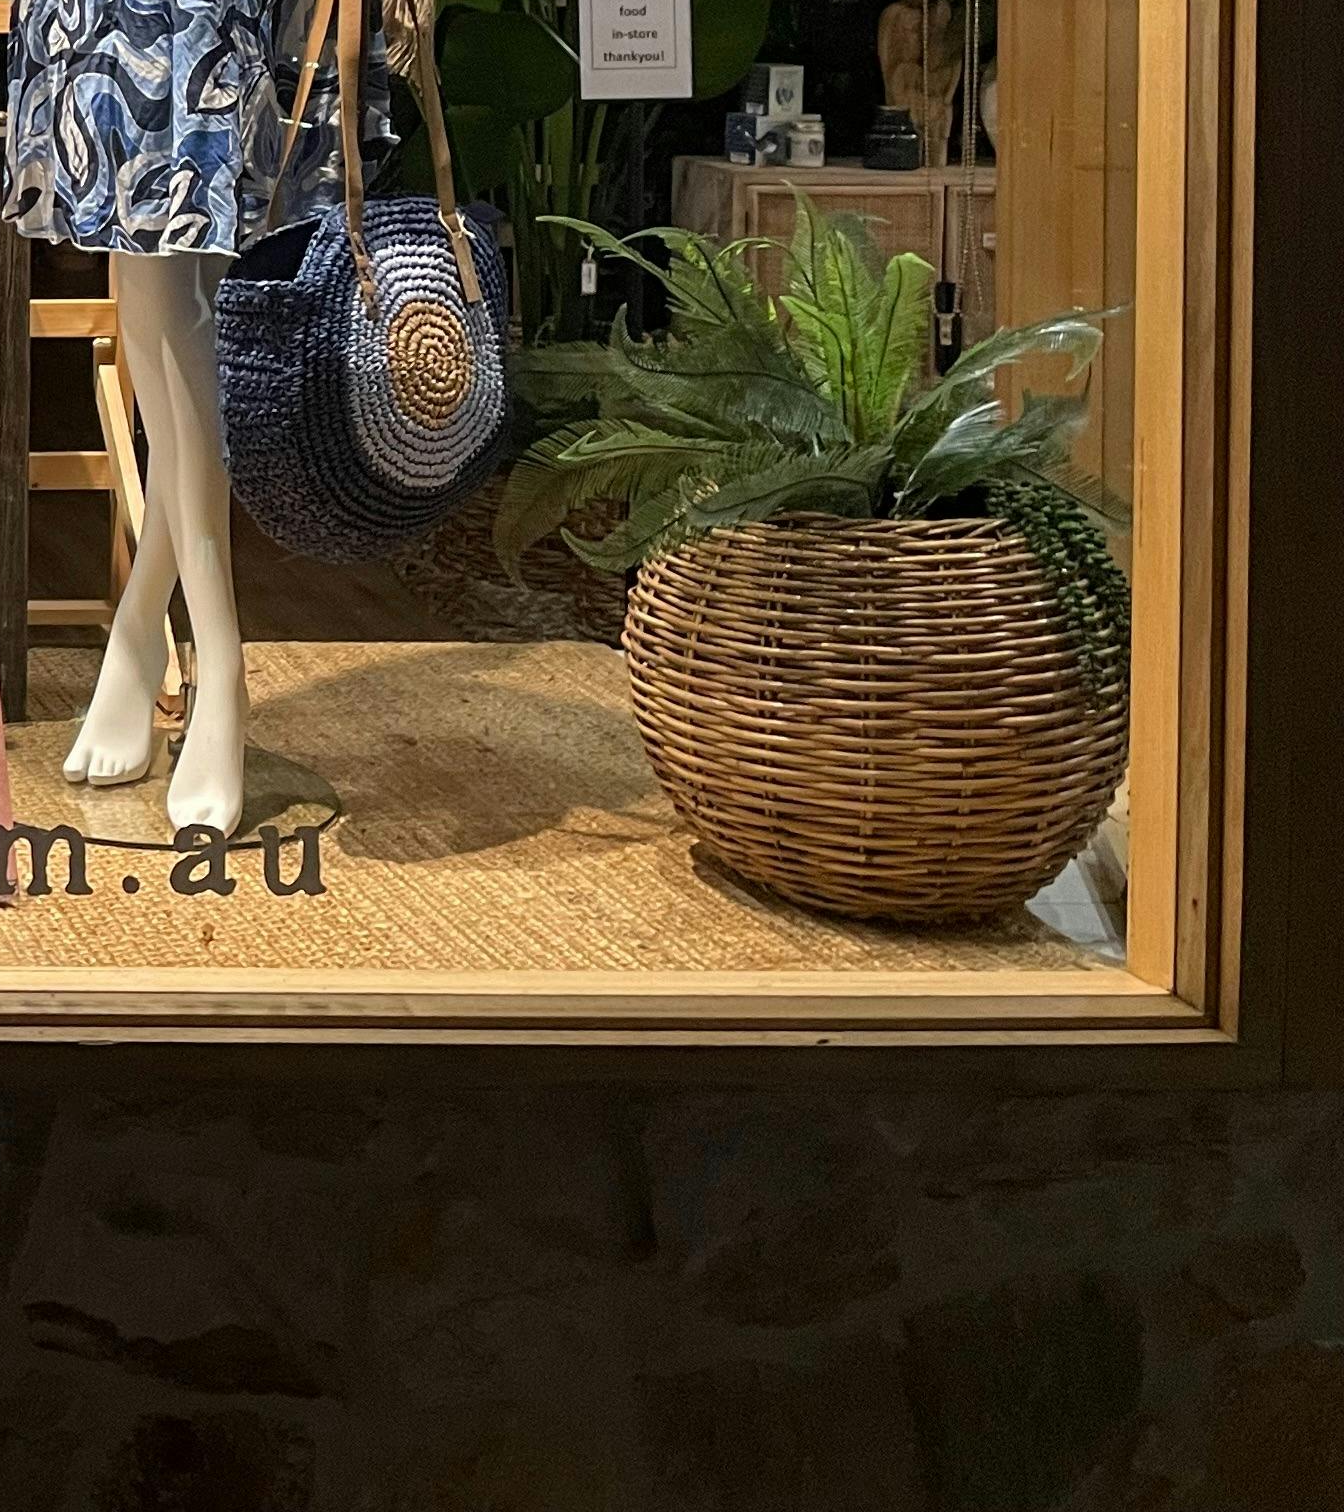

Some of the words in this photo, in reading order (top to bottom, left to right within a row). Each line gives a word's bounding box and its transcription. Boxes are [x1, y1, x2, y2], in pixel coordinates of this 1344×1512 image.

[619, 5, 647, 17] food
[612, 29, 658, 39] in-store
[603, 50, 665, 64] thankyou!
